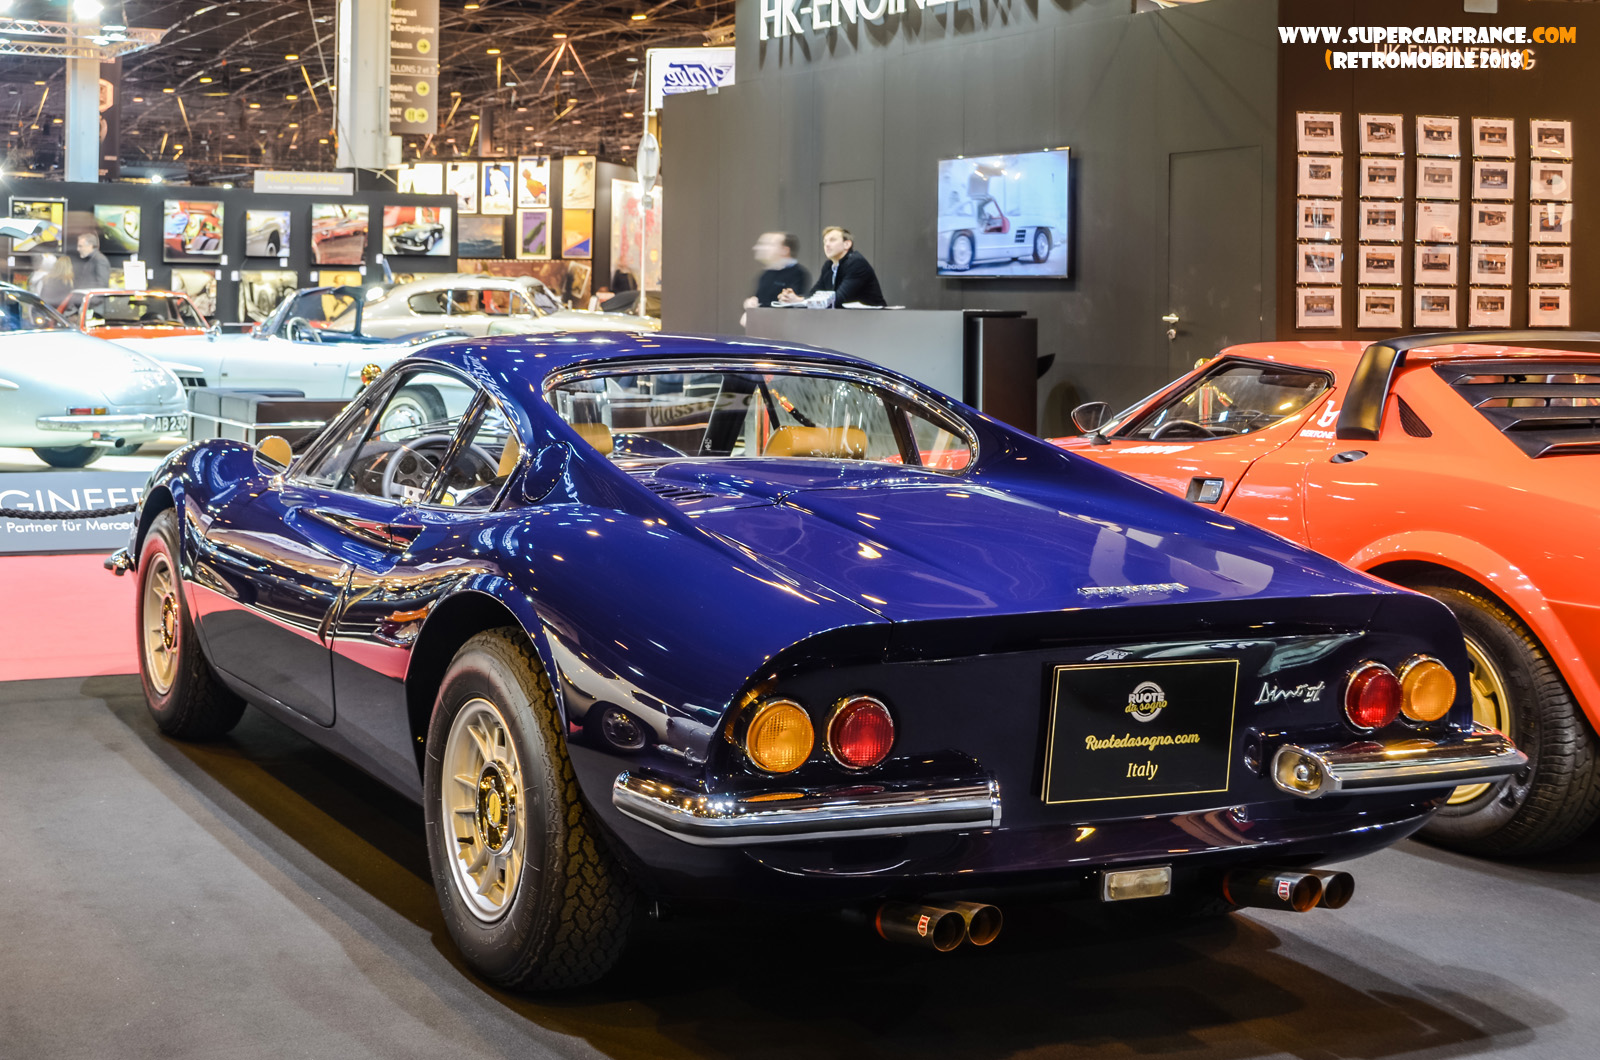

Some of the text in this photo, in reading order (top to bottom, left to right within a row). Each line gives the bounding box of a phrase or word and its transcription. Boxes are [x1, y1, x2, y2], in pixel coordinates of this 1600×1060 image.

[391, 9, 417, 17] ational
[391, 41, 413, 49] tisans
[391, 64, 416, 73] LLONS
[264, 173, 344, 185] PHOTOGRAPHIES
[1299, 429, 1336, 439] BERTONE
[6, 521, 58, 533] Partner
[62, 520, 82, 532] für
[1128, 692, 1165, 703] RUOTE
[1125, 700, 1168, 714] da sogno
[1085, 732, 1200, 751] Ruotedasogno.com
[1126, 761, 1159, 780] Italy
